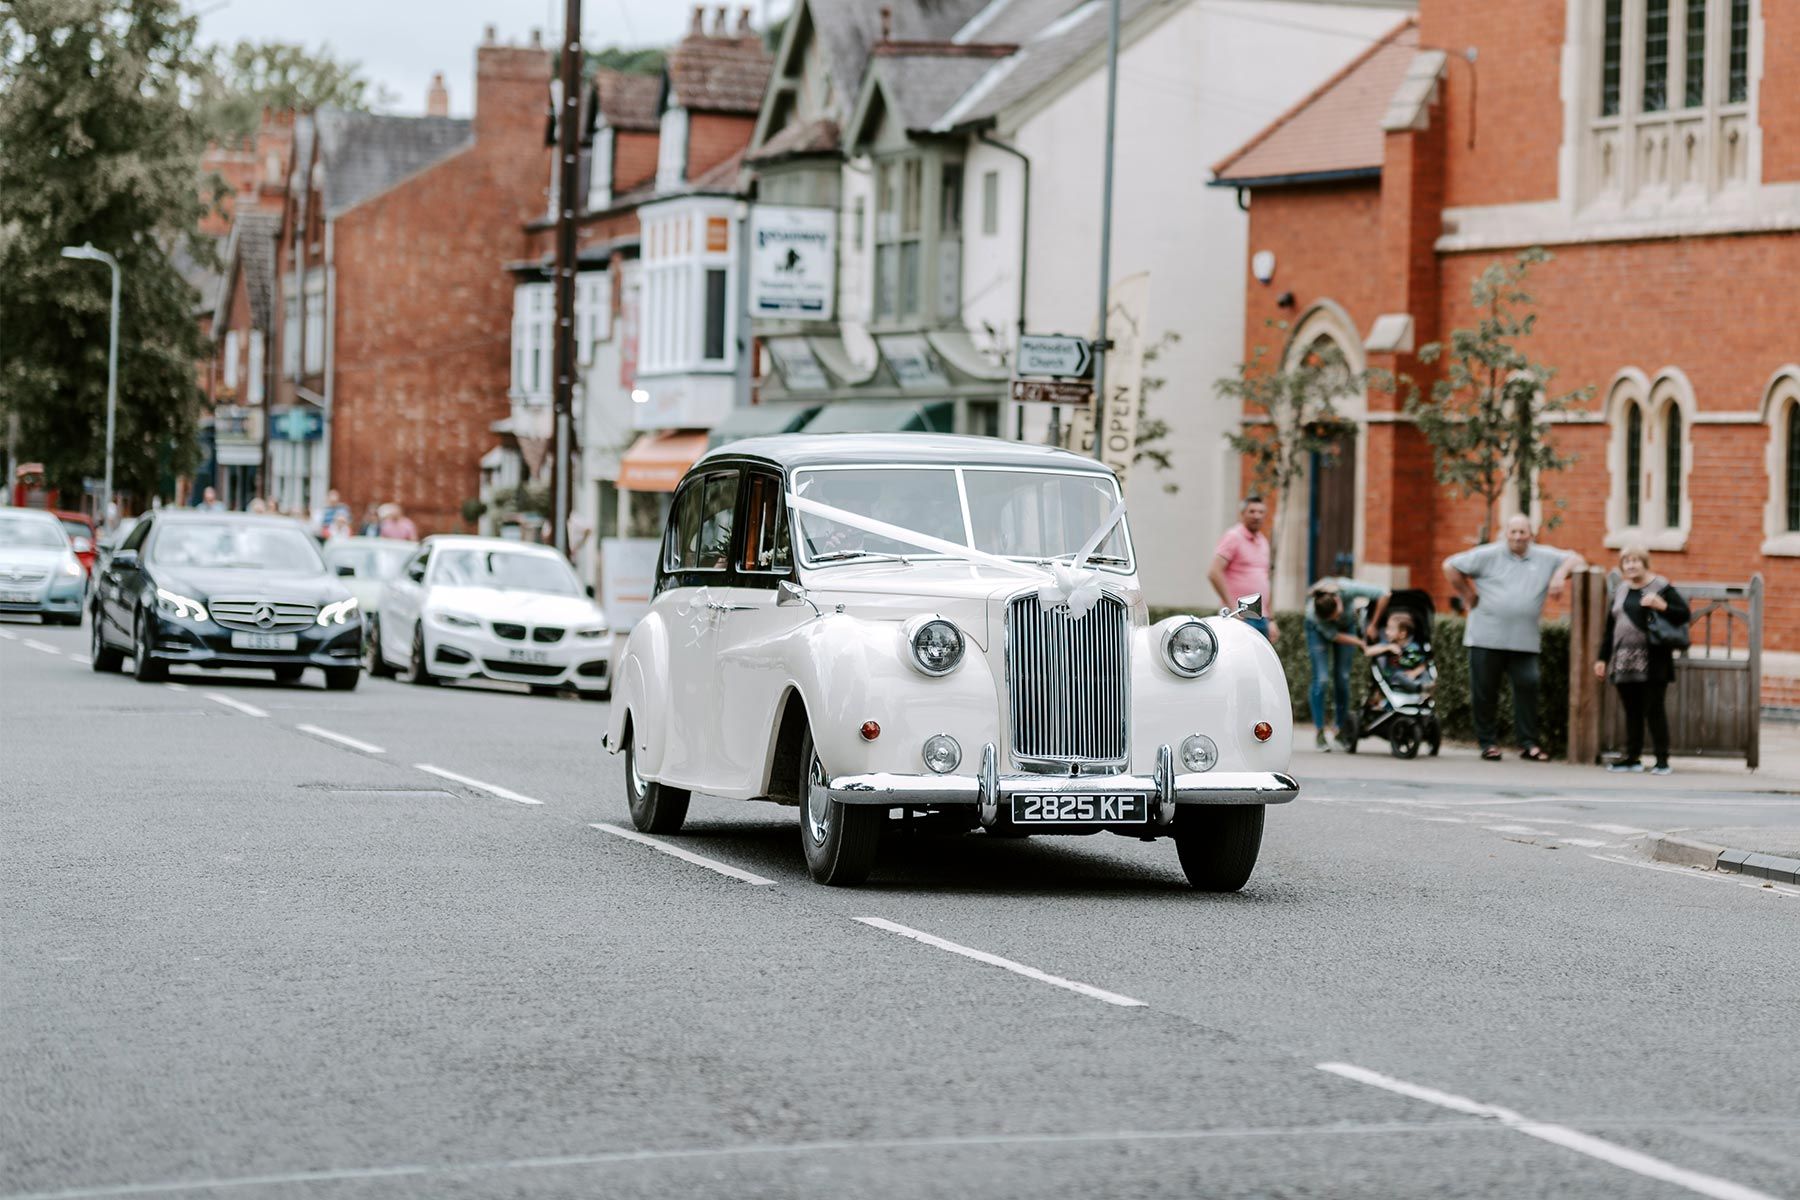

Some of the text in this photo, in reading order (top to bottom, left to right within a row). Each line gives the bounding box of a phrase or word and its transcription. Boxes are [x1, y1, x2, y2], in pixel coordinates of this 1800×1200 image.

[1109, 386, 1129, 452] OPEN
[1024, 796, 1135, 819] 2825 KF
